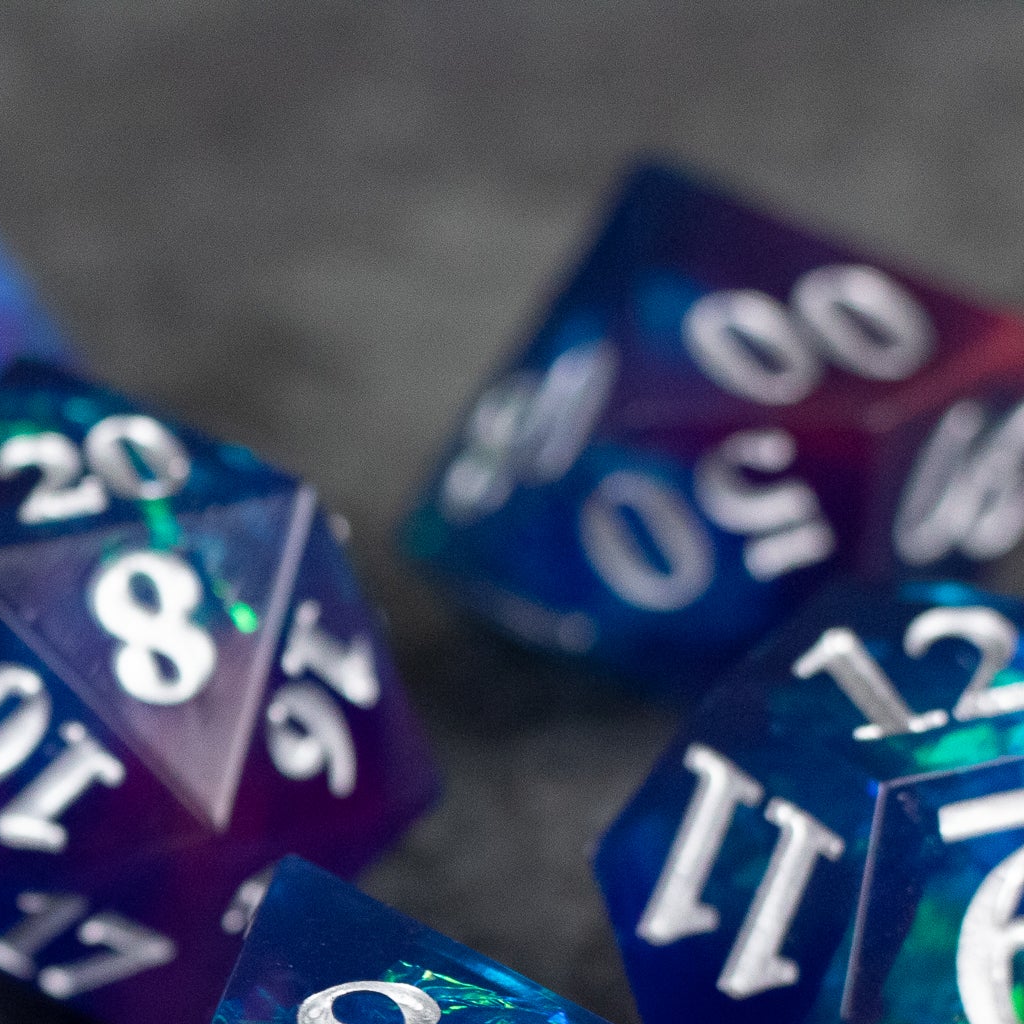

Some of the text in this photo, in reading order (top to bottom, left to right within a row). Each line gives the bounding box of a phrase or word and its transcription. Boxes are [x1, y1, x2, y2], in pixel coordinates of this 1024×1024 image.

[682, 262, 936, 405] 00
[89, 550, 218, 706] 8
[793, 606, 1024, 738] 12
